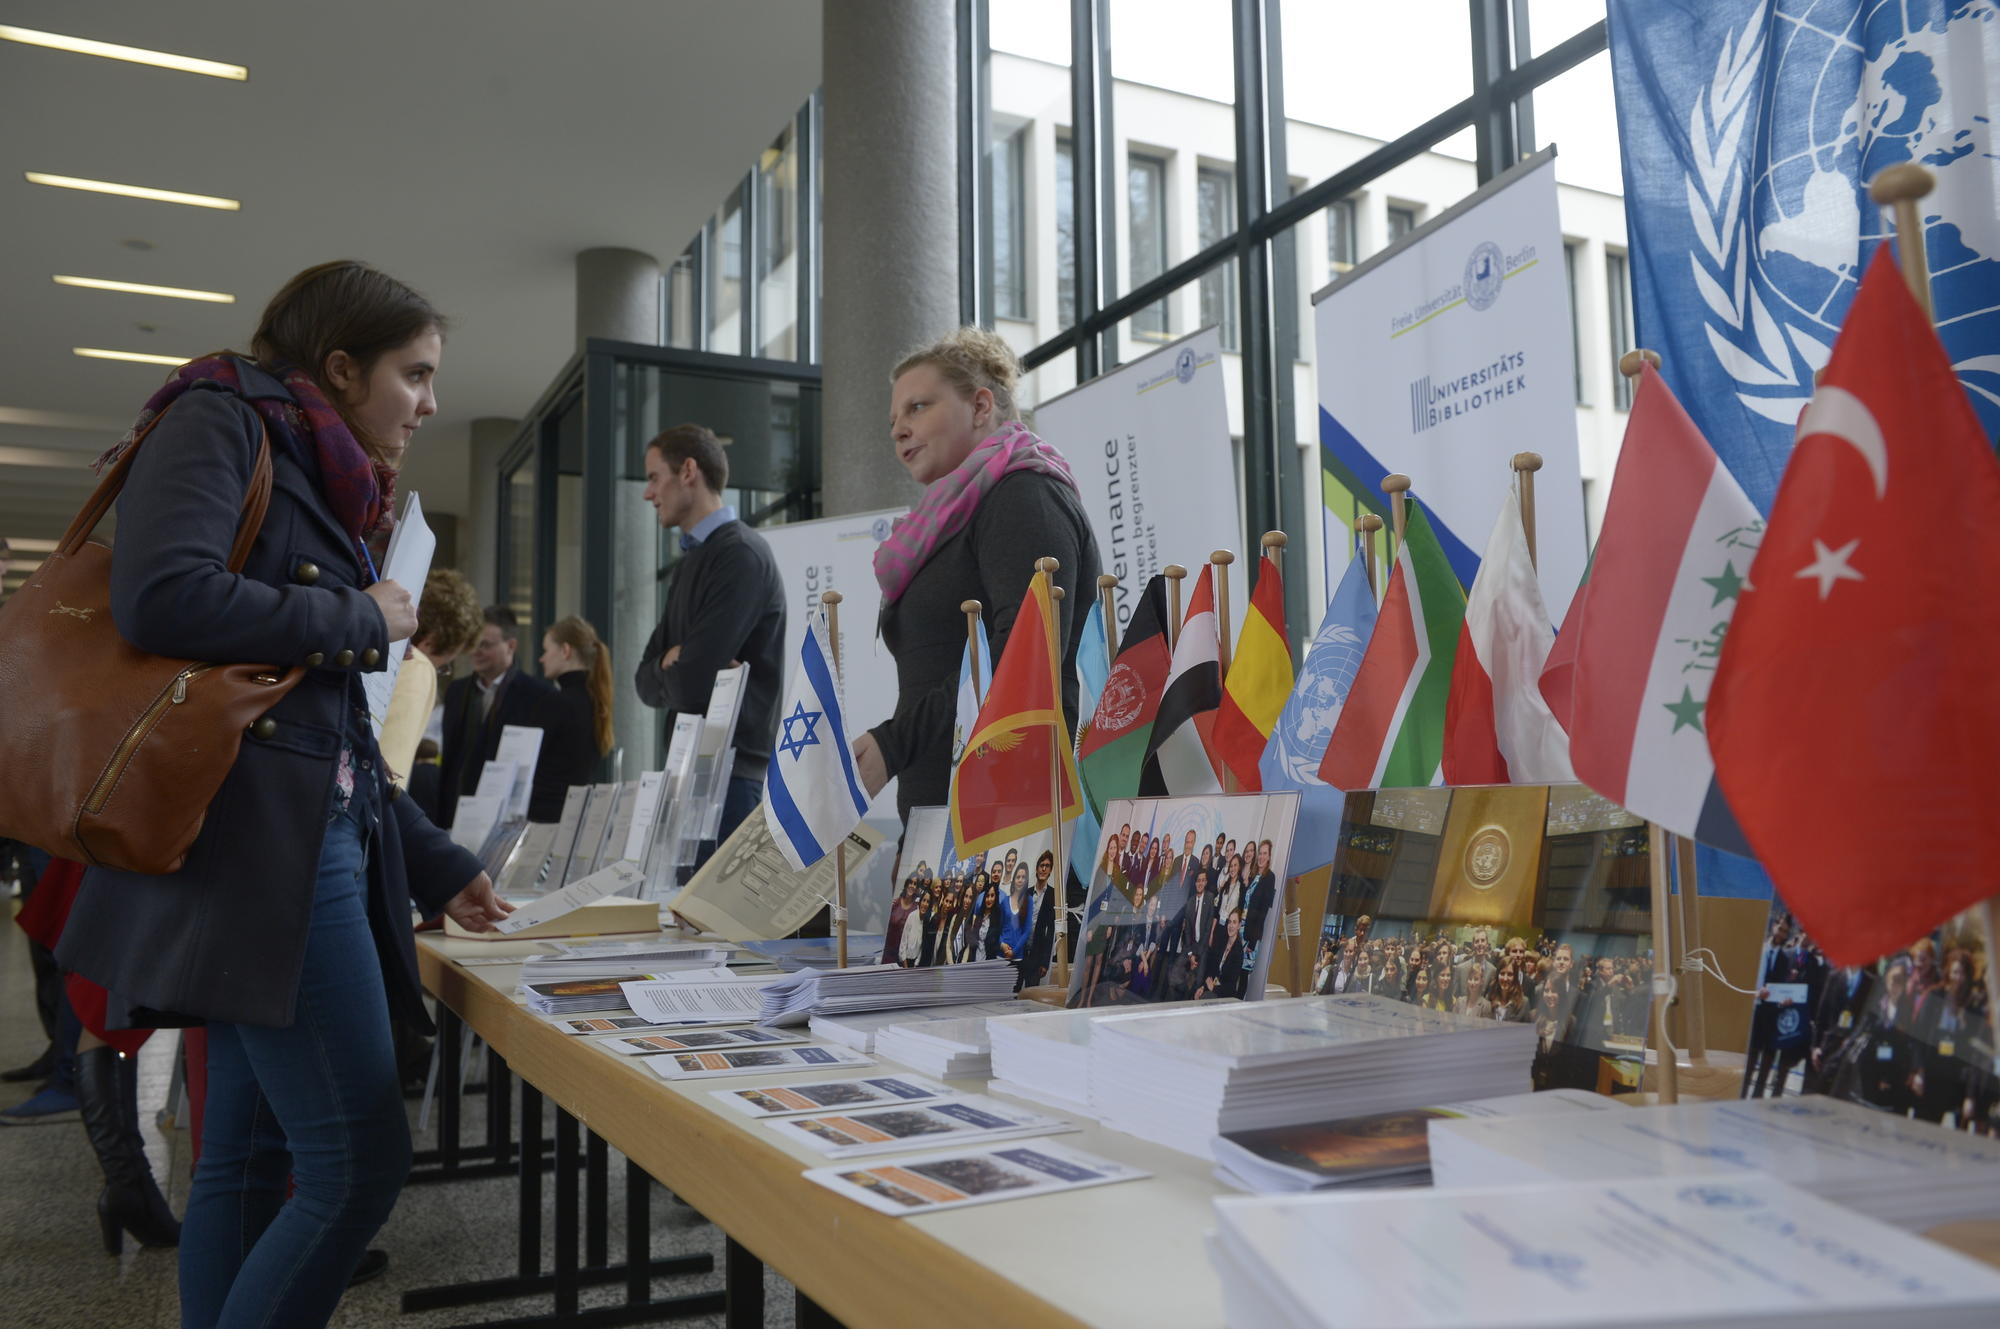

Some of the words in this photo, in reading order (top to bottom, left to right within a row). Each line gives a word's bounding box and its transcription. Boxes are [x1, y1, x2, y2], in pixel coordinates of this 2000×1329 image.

[1505, 245, 1537, 271] Berlin
[1427, 351, 1525, 405] UNIVERSITÄTS
[1429, 375, 1526, 427] BIBLIOTHEK
[1127, 434, 1144, 540] begrenzter
[1105, 439, 1131, 637] overnance
